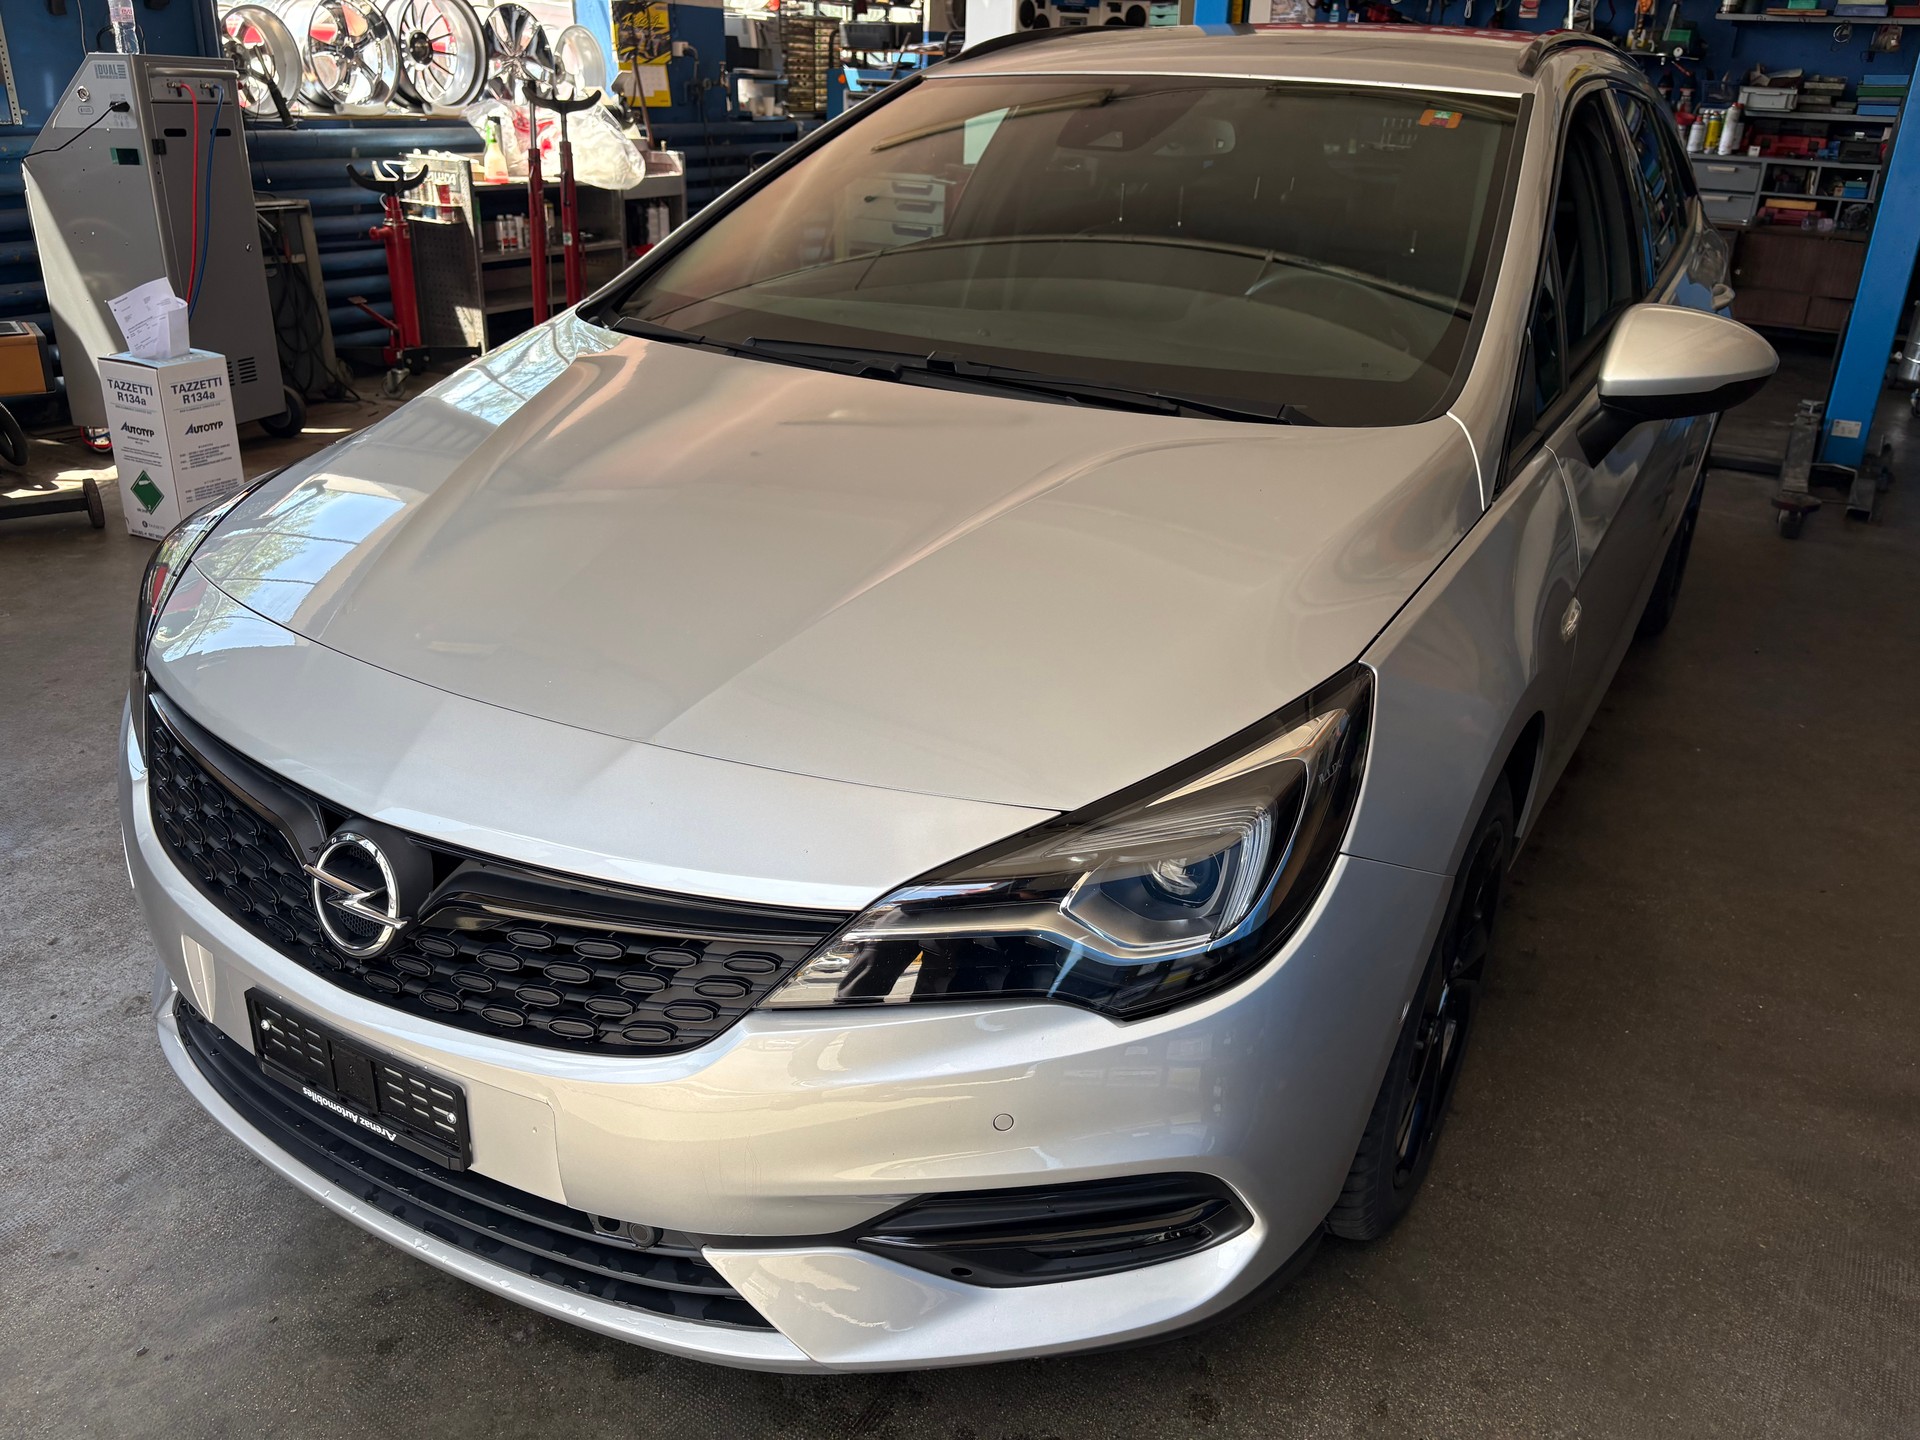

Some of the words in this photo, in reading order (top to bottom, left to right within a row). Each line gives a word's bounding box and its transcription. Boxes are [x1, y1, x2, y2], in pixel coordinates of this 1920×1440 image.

[107, 378, 153, 396] TAZZETTI
[171, 377, 223, 395] TAZZETTI
[117, 391, 147, 406] R134a
[182, 391, 216, 404] R134a
[302, 1086, 358, 1123] Automobiles
[360, 1117, 397, 1141] Arenaz
